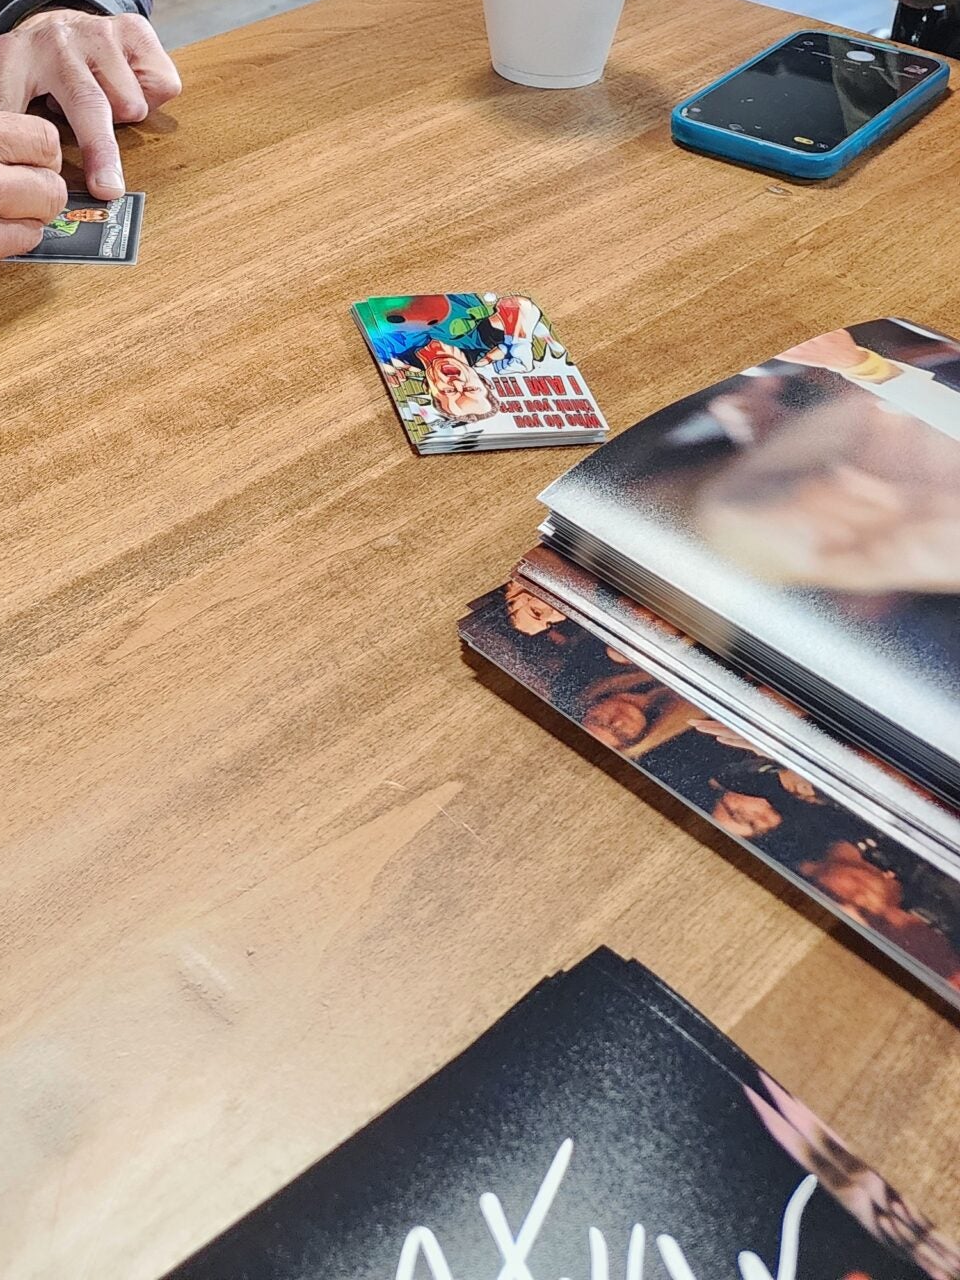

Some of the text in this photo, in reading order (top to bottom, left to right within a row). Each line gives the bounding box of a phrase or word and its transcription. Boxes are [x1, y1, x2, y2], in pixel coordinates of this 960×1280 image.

[523, 376, 567, 396] AM
[567, 375, 583, 395] I
[523, 398, 554, 412] you
[553, 399, 595, 413] think
[513, 413, 603, 429] Who do you
